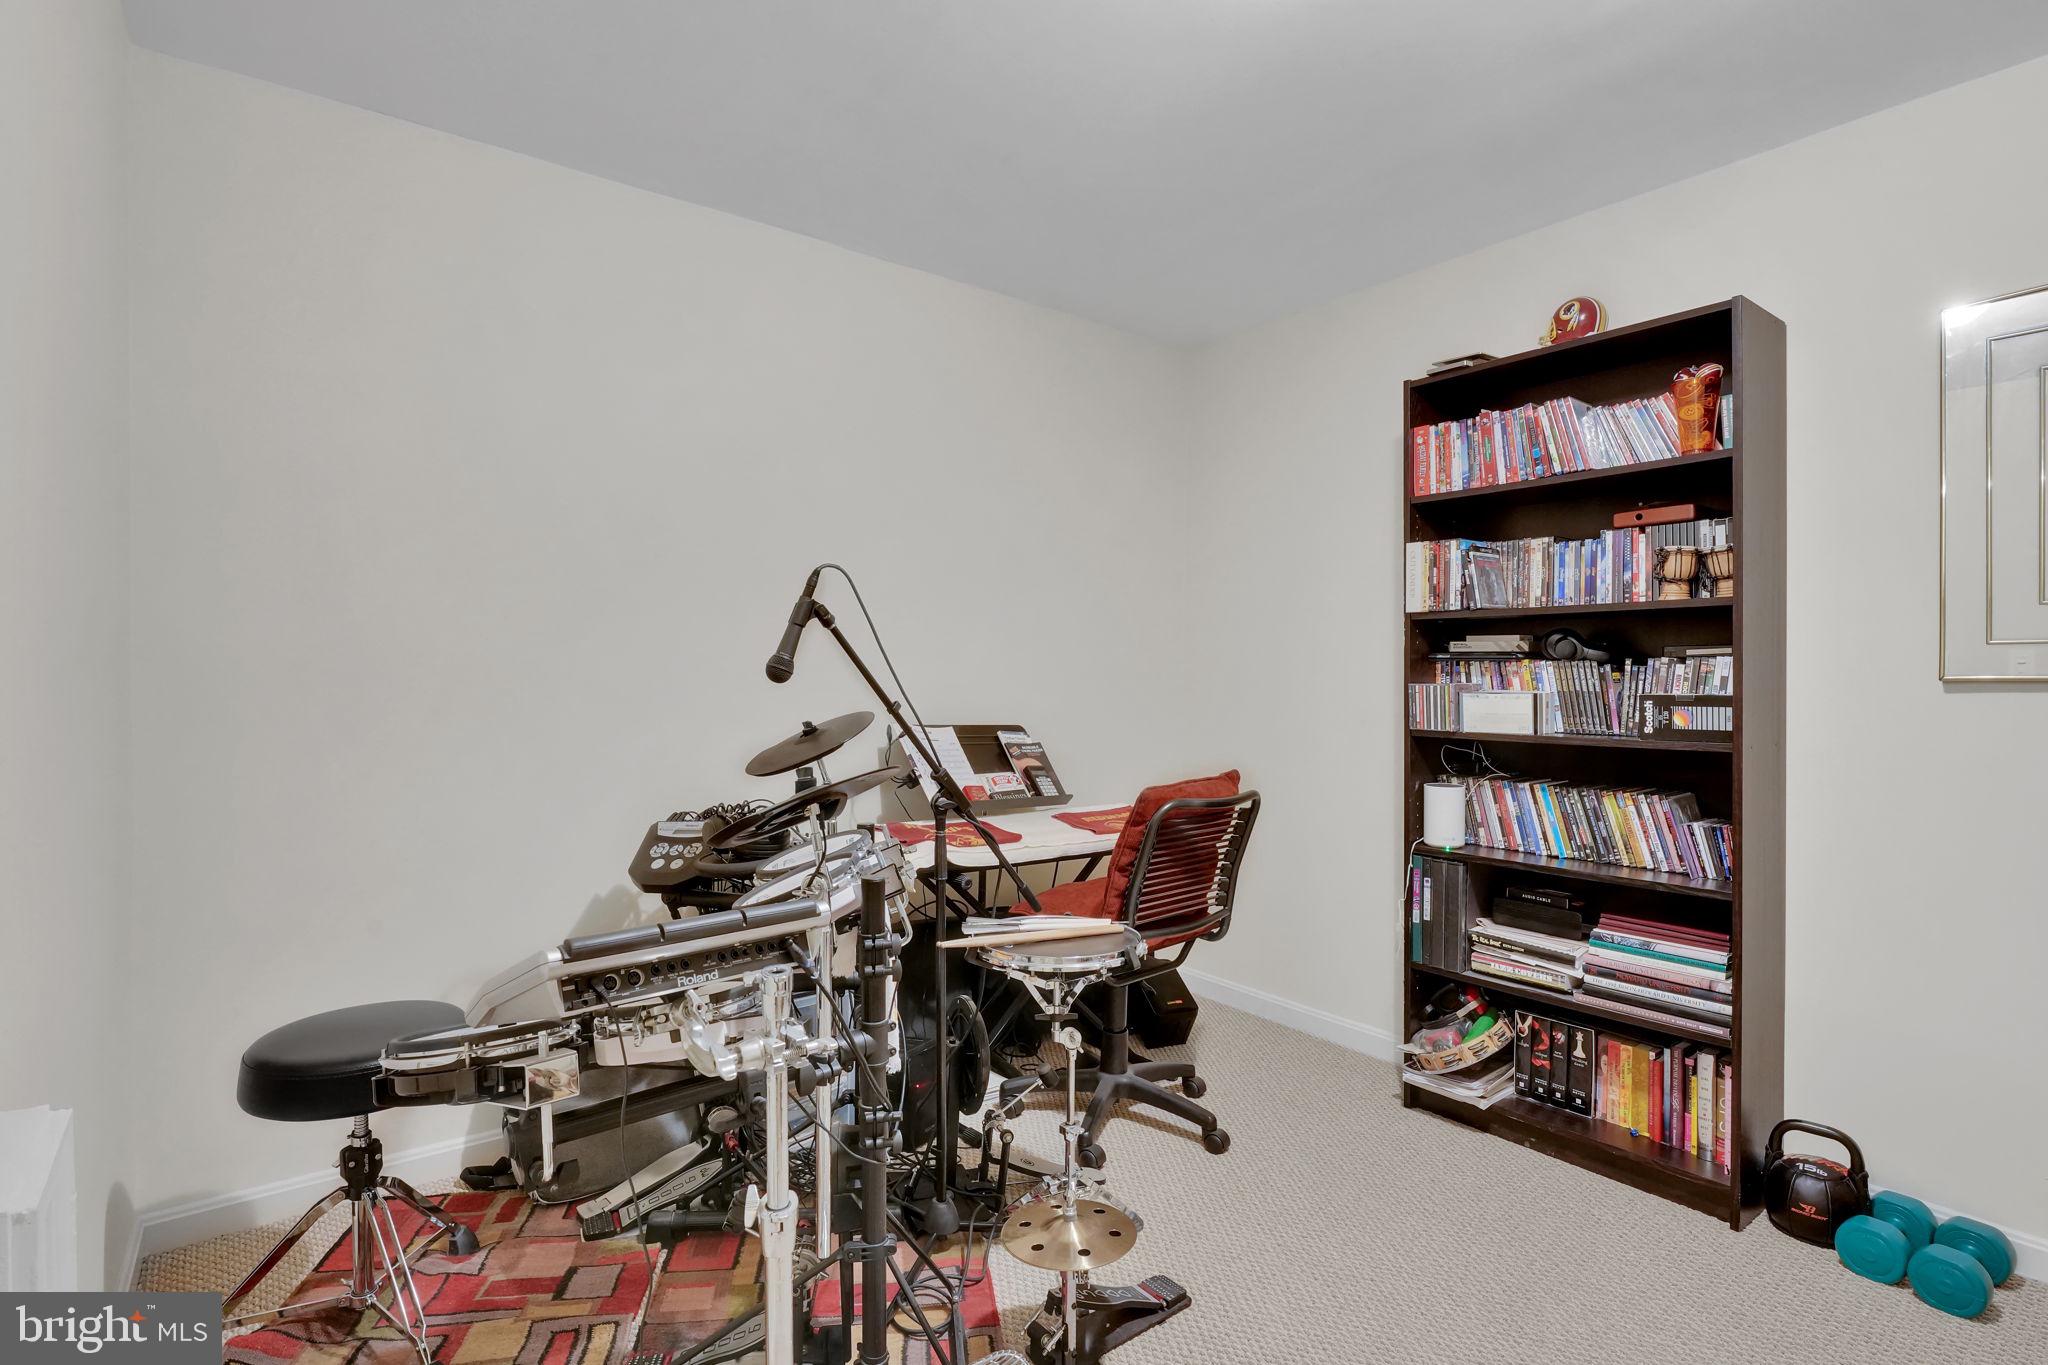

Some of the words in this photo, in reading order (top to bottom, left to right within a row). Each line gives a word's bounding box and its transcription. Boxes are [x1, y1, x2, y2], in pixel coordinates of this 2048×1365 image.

[1644, 701, 1653, 734] Scotch
[1522, 893, 1536, 901] AUDIO
[677, 969, 719, 988] Roland
[1616, 972, 1647, 985] HOWARD
[1648, 980, 1692, 995] UNIVERSITY
[1668, 993, 1707, 1008] UNIVERSITY
[1795, 1163, 1828, 1177] 15lb
